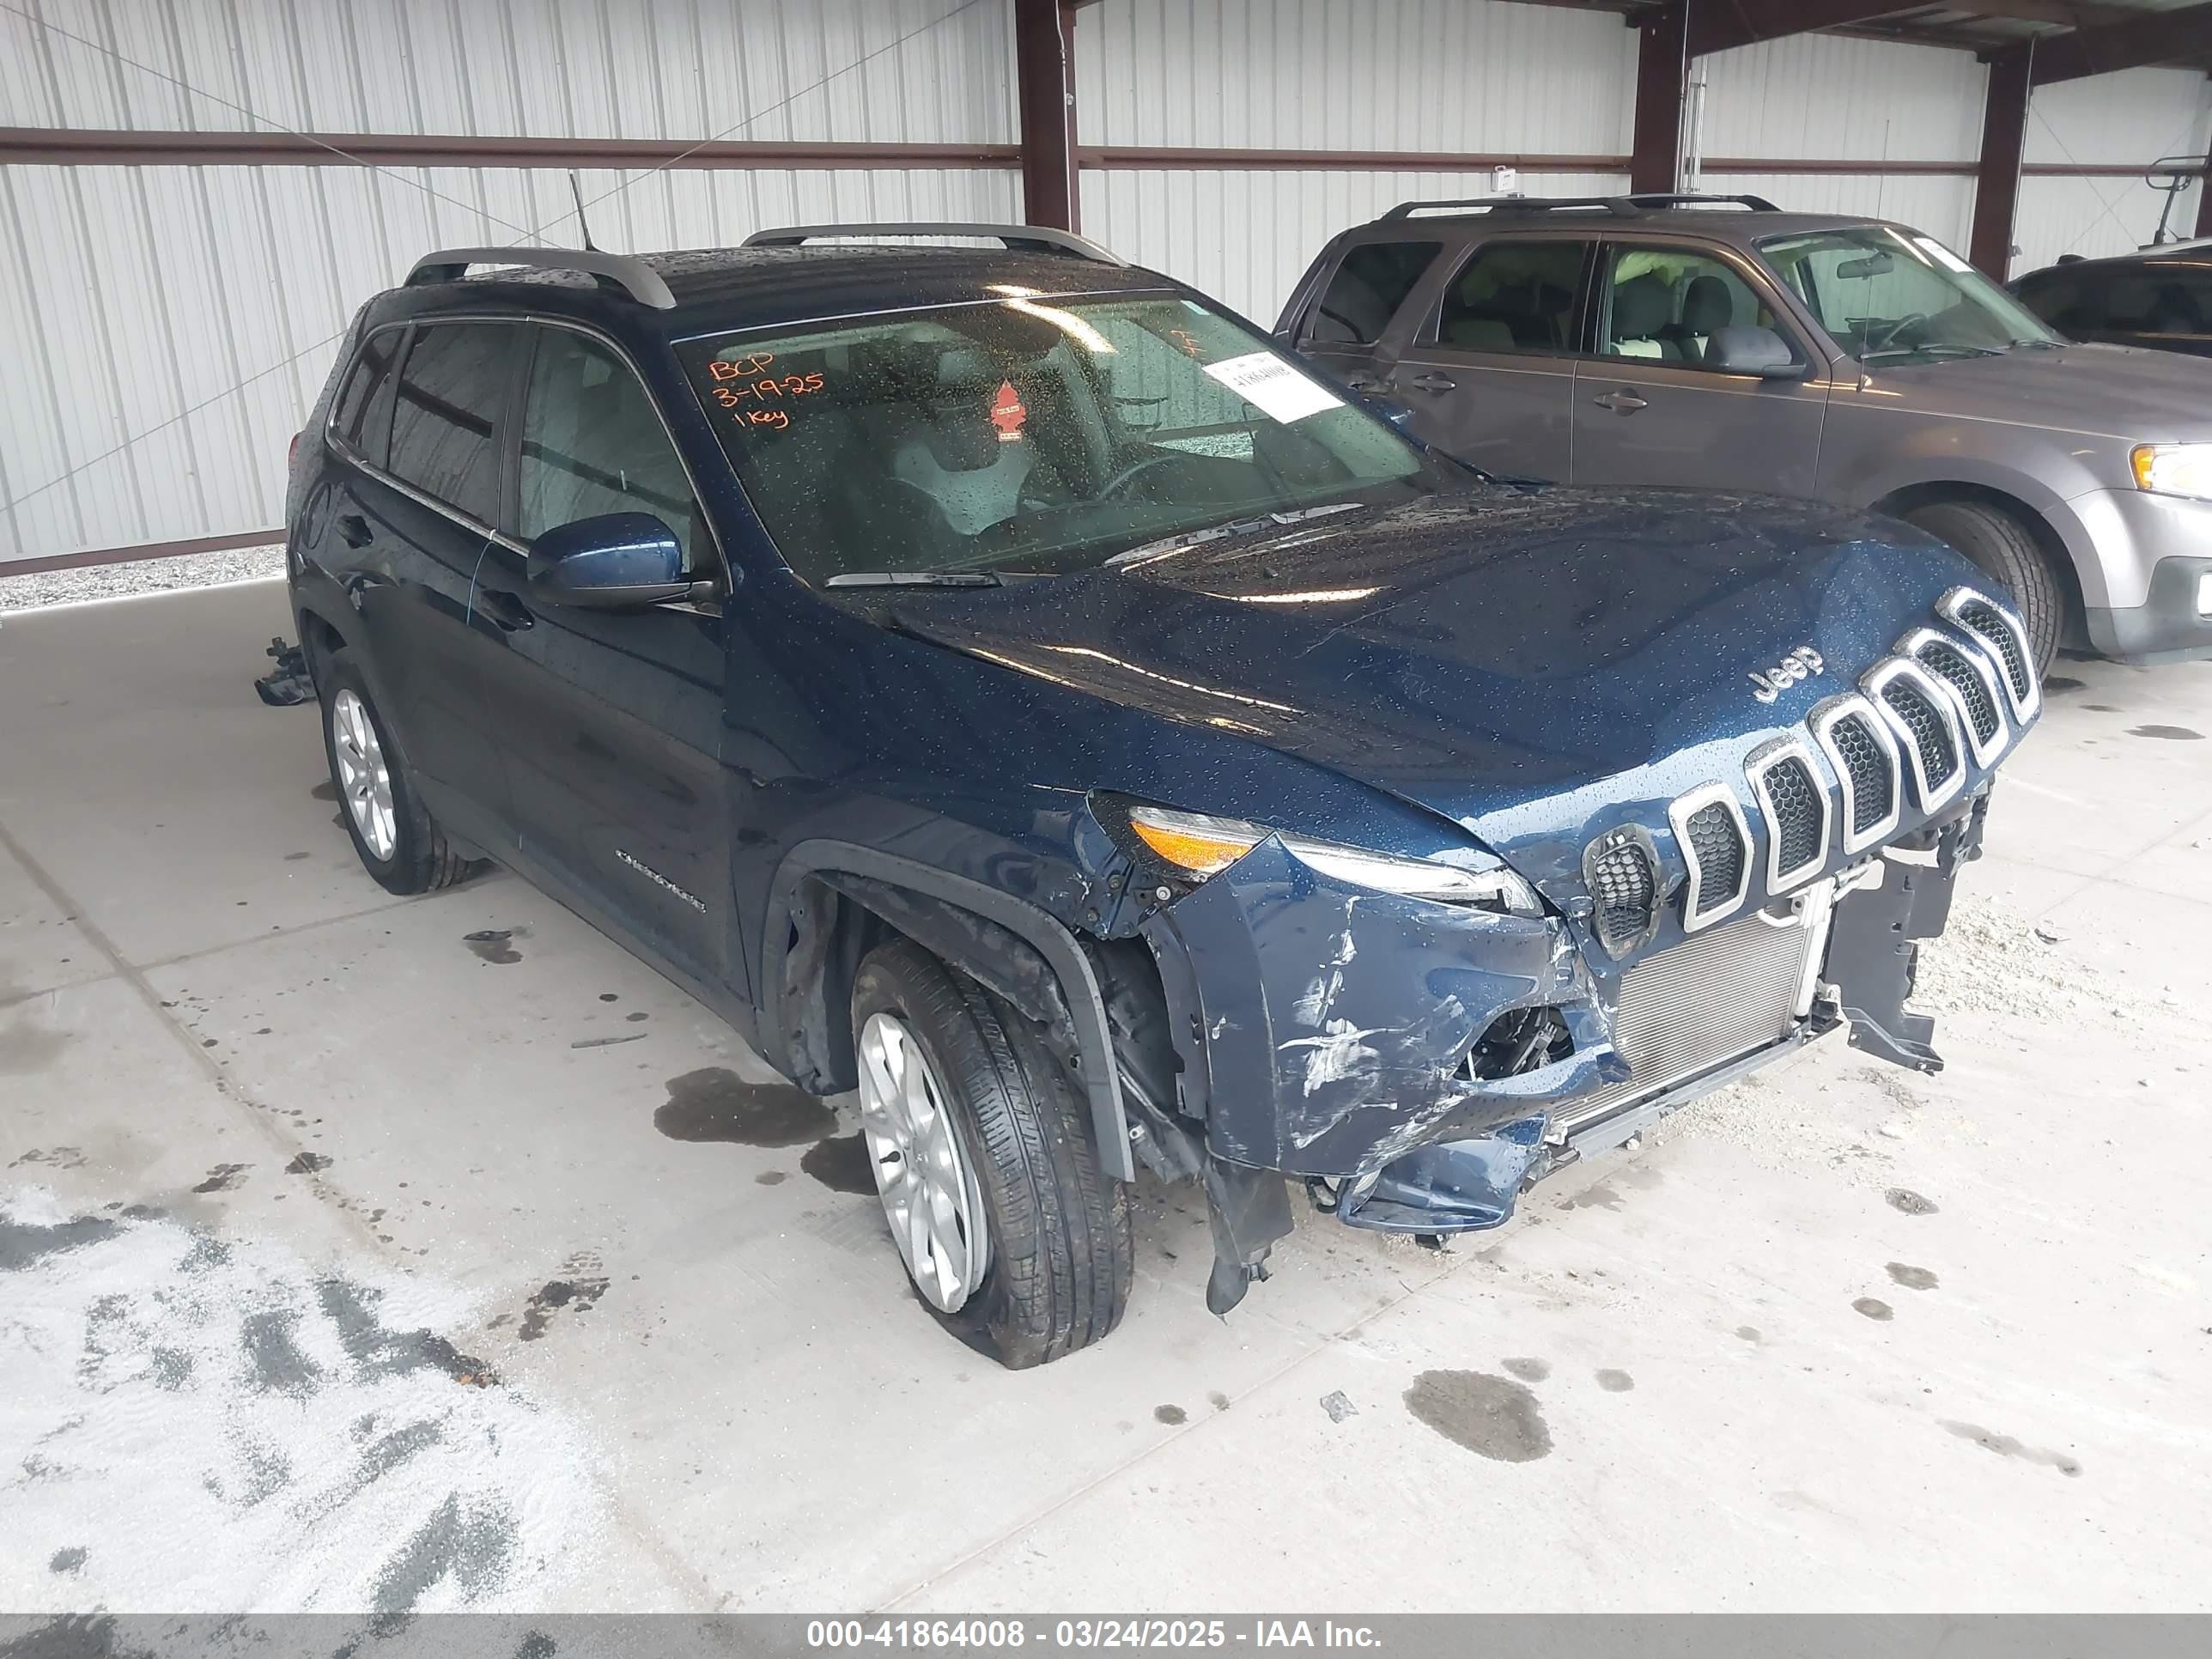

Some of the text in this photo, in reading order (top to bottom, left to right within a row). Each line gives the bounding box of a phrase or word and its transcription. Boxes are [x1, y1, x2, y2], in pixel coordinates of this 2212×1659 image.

[710, 352, 773, 380] BCP
[713, 374, 824, 407] 3-19-25
[1747, 646, 1824, 703] Jeep
